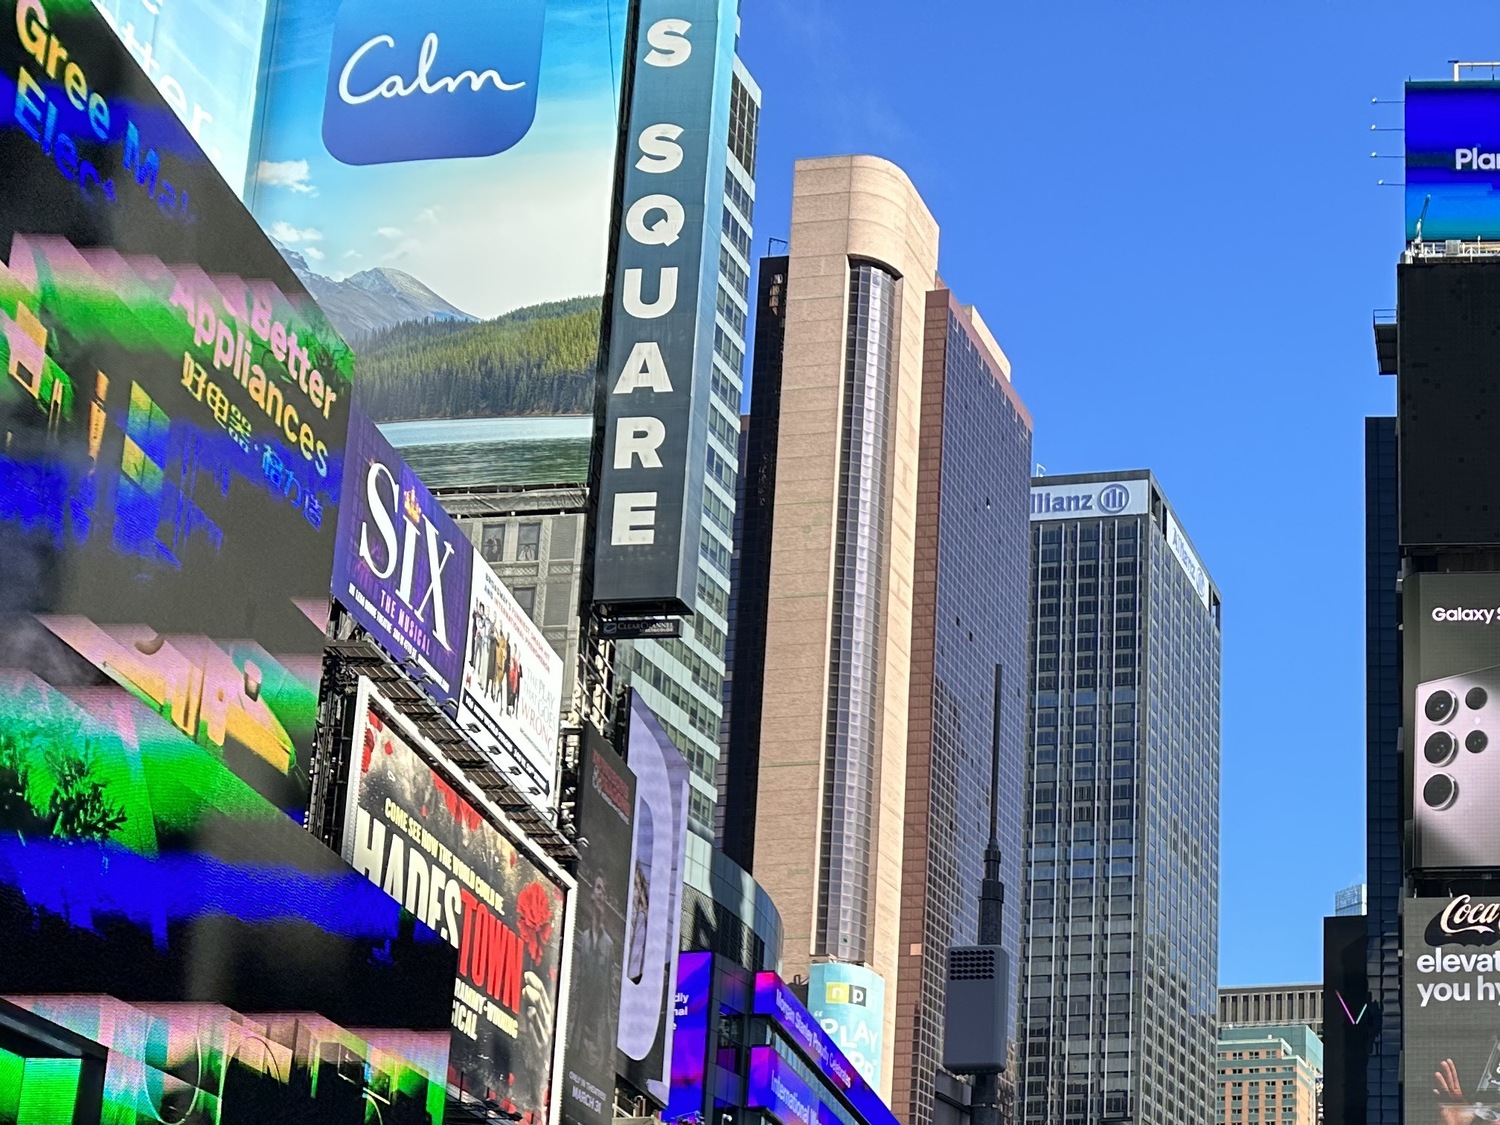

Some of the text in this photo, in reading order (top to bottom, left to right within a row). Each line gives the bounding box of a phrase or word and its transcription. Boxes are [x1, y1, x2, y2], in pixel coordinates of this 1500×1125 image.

[16, 0, 111, 141] Gree
[339, 32, 527, 105] Calm
[251, 292, 337, 419] Better
[610, 123, 686, 546] SQUARE
[170, 276, 329, 478] Appliances
[1030, 492, 1093, 513] llianz
[359, 462, 455, 652] SIX
[380, 589, 396, 619] THE
[398, 606, 431, 656] MUSICAL
[1432, 606, 1494, 626] Galaxy
[520, 697, 555, 756] WRONG
[384, 797, 407, 828] COME
[406, 816, 422, 842] SEE
[439, 844, 453, 870] THE
[1416, 981, 1471, 1007] you
